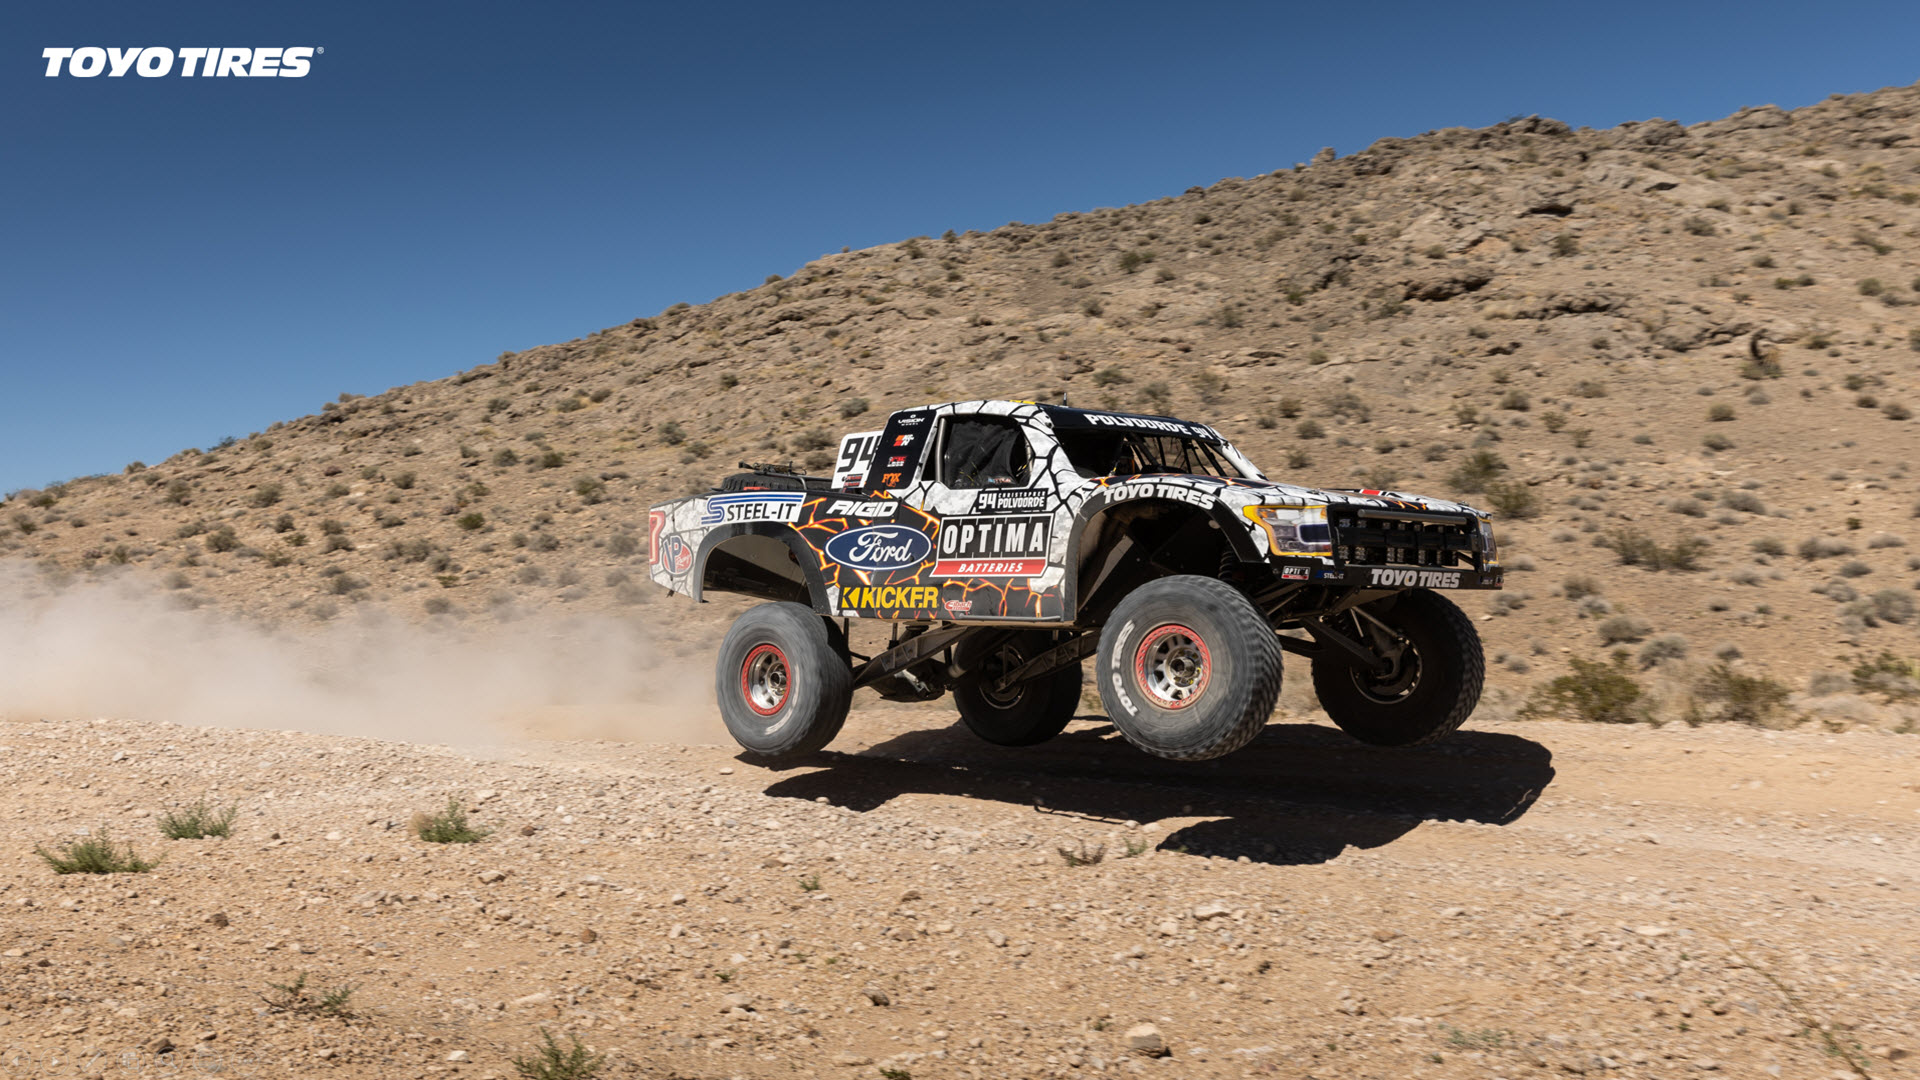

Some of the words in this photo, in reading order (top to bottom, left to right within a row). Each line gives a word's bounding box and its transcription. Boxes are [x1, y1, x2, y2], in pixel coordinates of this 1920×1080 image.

[1083, 414, 1192, 435] POLVOORDE
[1190, 426, 1213, 440] 94
[837, 435, 881, 472] 94
[882, 473, 902, 486] FOX
[979, 493, 997, 509] 94
[997, 497, 1045, 509] POLVOORDE
[998, 491, 1046, 499] CHRISTOPHER
[1103, 484, 1154, 504] TOYO
[1155, 484, 1216, 510] TIRES
[727, 503, 797, 521] STEEL-IT
[826, 501, 898, 517] RIGID
[849, 532, 912, 563] Ford
[943, 522, 1043, 554] OPTIMA
[663, 536, 682, 573] VP
[958, 563, 1023, 573] BATTERIES
[1284, 567, 1309, 575] OPTIA
[1371, 568, 1417, 587] TOYO
[1419, 571, 1461, 588] TIRES
[861, 586, 939, 609] KICKER
[1112, 672, 1138, 717] TOYO
